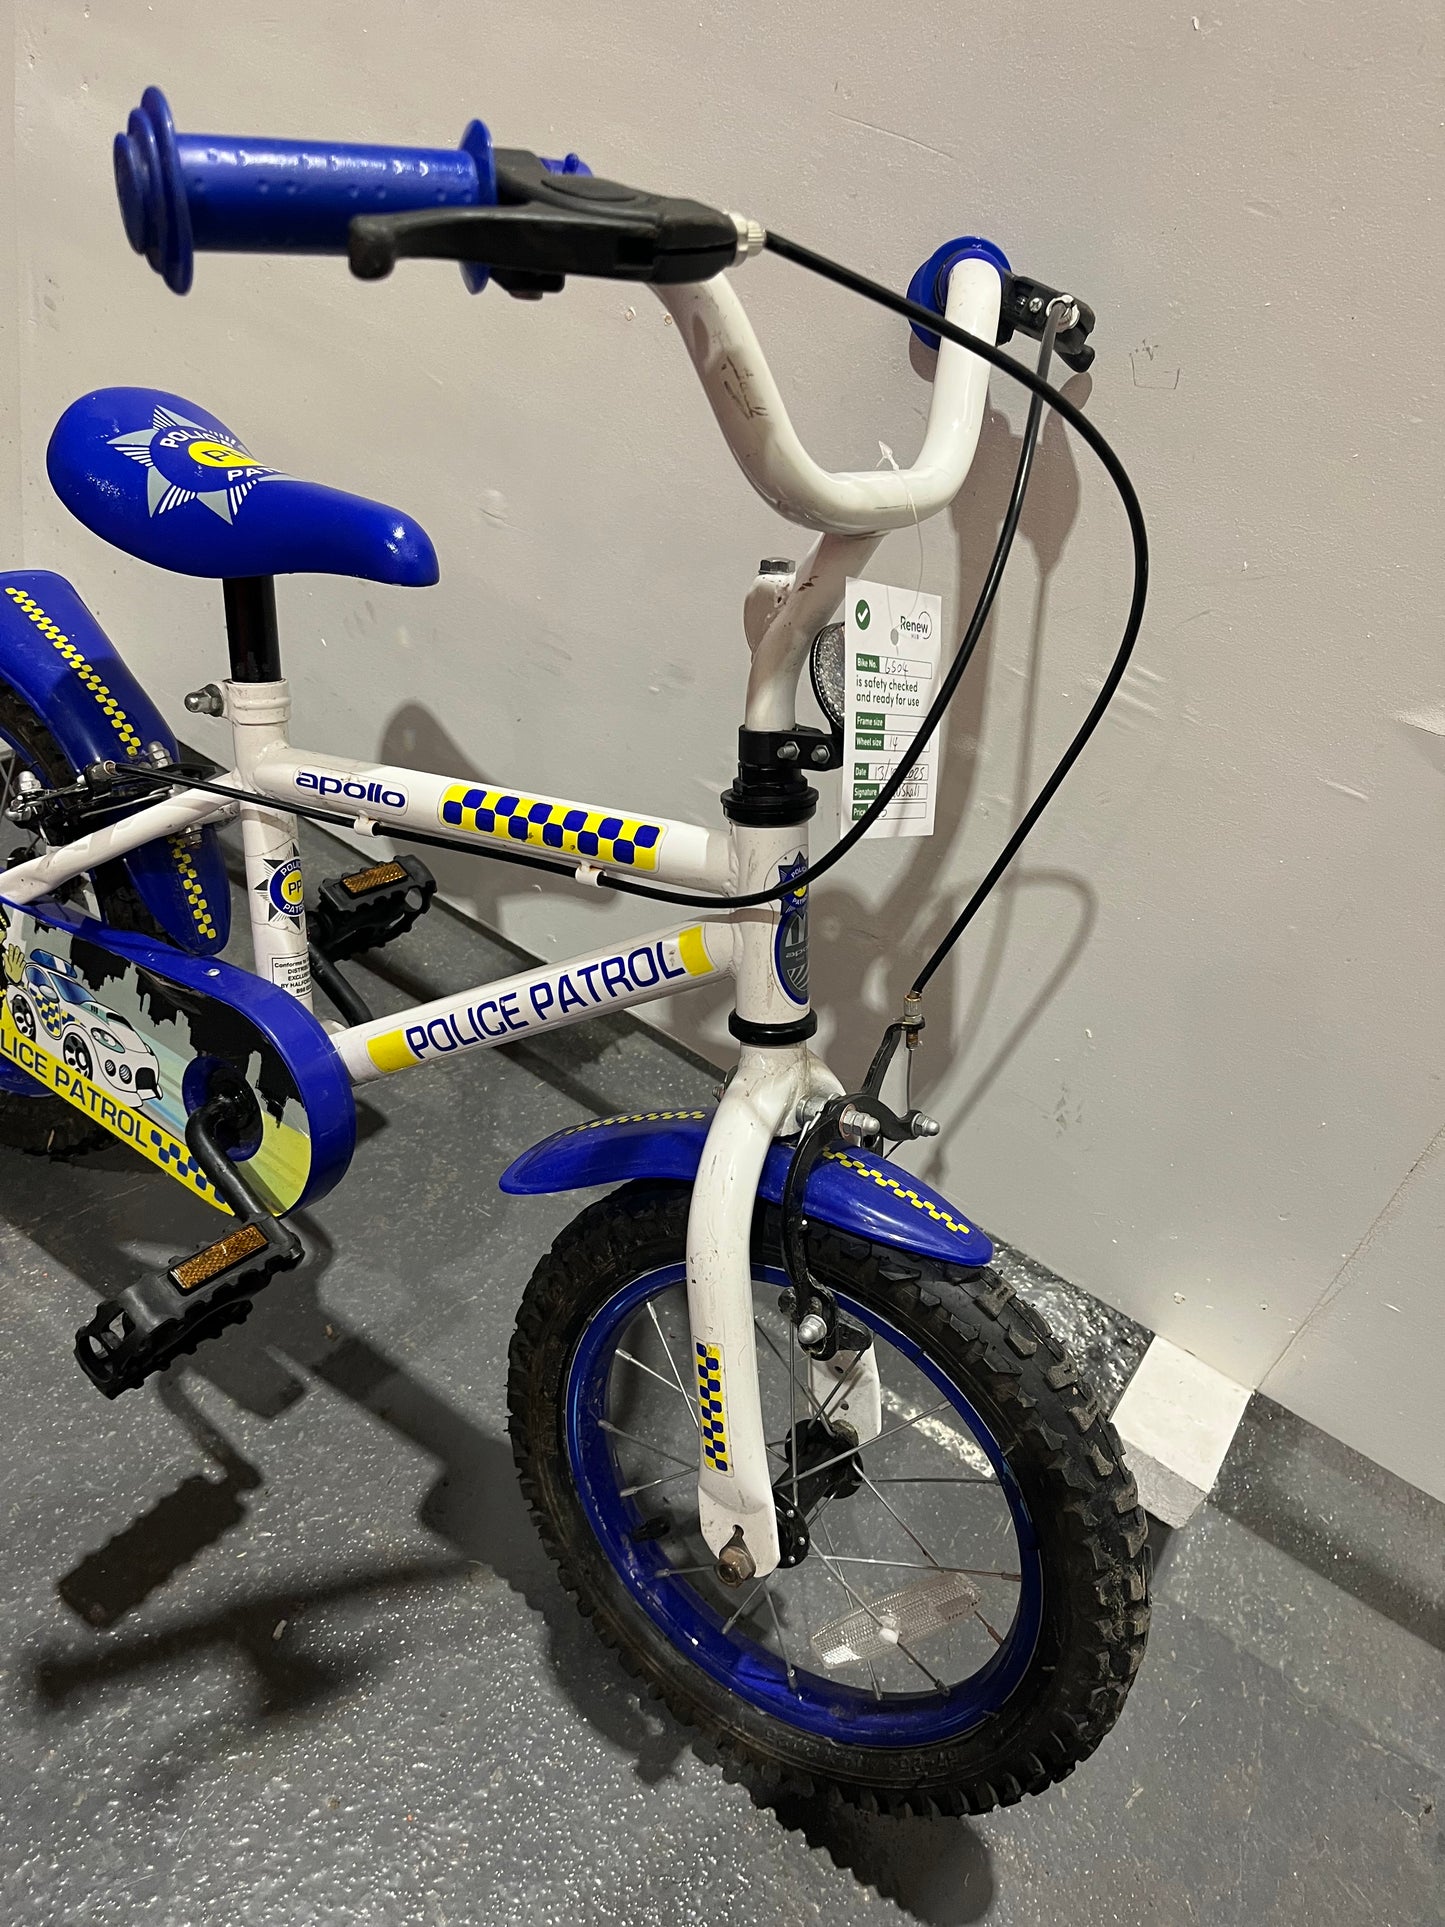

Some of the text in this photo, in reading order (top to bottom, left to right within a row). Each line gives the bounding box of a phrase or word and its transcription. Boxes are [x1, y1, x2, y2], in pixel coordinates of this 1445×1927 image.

[900, 615, 929, 634] Renew
[857, 657, 878, 669] Bike No.
[856, 675, 918, 692] is safety checked
[856, 691, 920, 708] and ready for use
[857, 716, 883, 726] Frame size
[856, 736, 882, 746] Wheel size
[855, 767, 867, 776] Date
[296, 771, 405, 808] apollo
[854, 787, 877, 798] Signature
[406, 941, 686, 1059] POLICE PATROL
[0, 1029, 148, 1148] LICE PATROL
